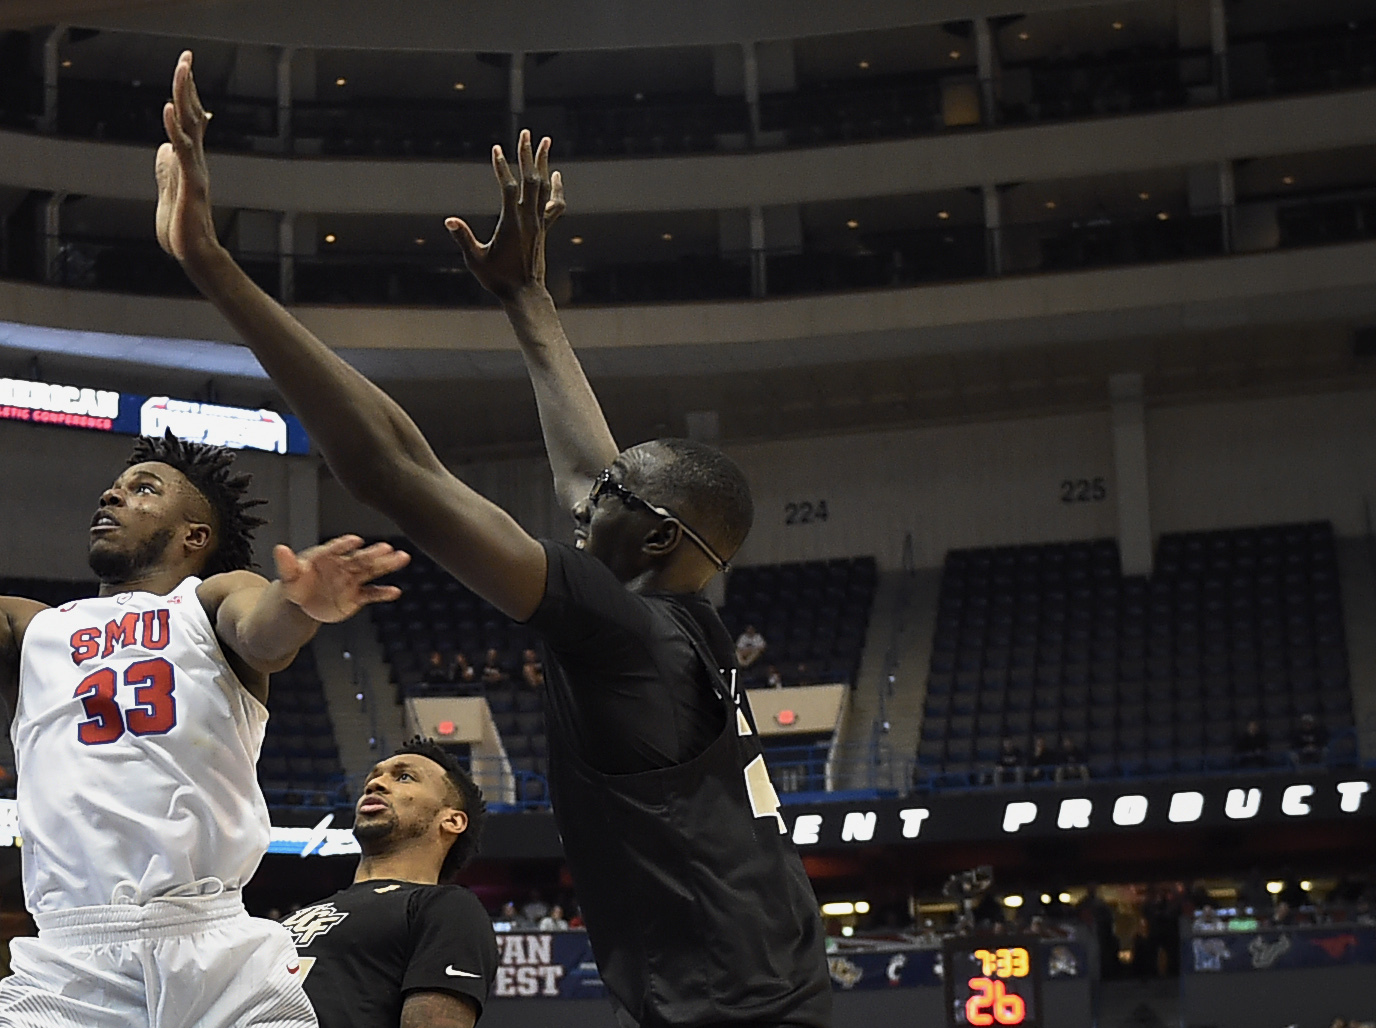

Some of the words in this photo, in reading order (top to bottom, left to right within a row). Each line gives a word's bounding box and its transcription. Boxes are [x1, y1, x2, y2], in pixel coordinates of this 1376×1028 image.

[32, 409, 113, 431] CONFERENCE
[1060, 477, 1106, 503] 225
[785, 499, 829, 526] 224
[70, 609, 170, 667] SMU
[74, 657, 177, 746] 33
[974, 947, 1030, 978] 7:33
[965, 977, 1026, 1026] 26
